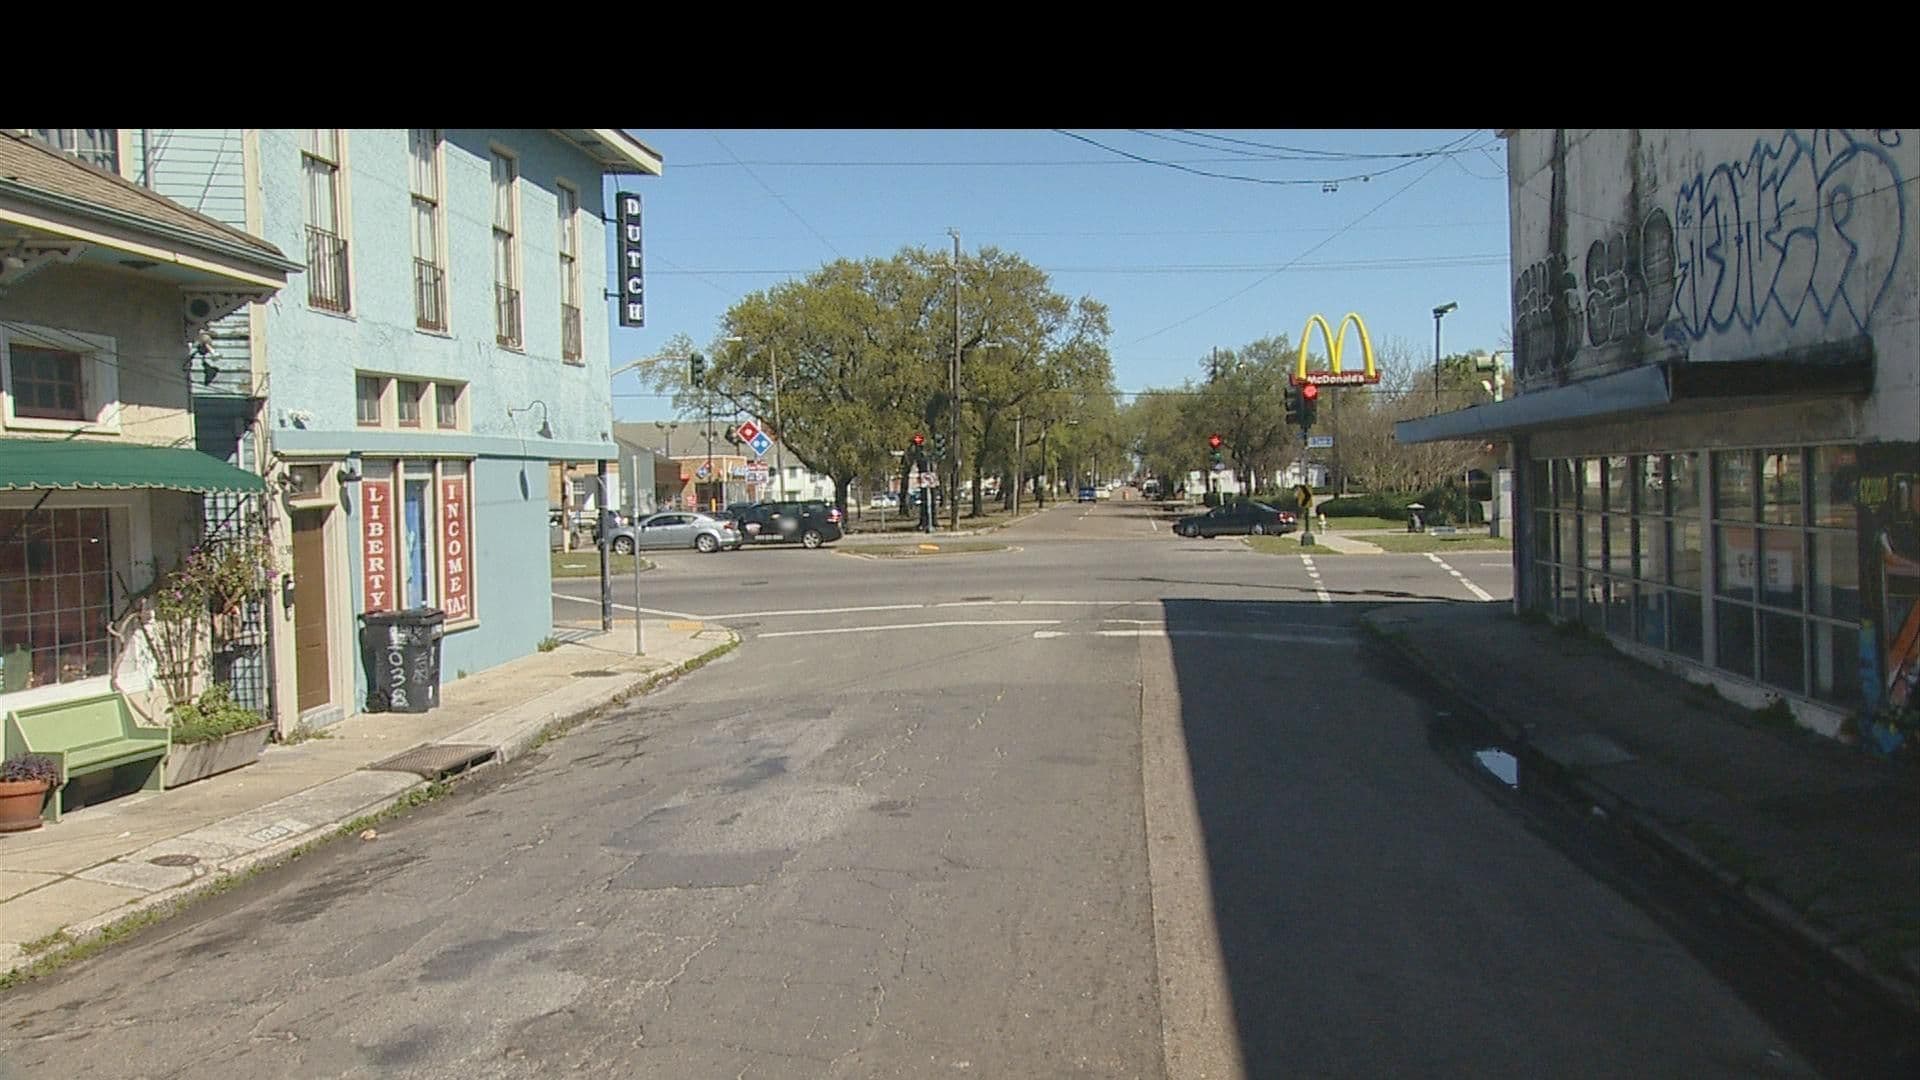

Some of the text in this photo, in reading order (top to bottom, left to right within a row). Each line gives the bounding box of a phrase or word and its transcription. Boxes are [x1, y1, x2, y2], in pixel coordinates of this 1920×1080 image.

[627, 198, 642, 321] DUTCH
[1307, 374, 1365, 385] McDonald's
[368, 486, 385, 607] LIBERTY
[448, 484, 463, 593] INCOME
